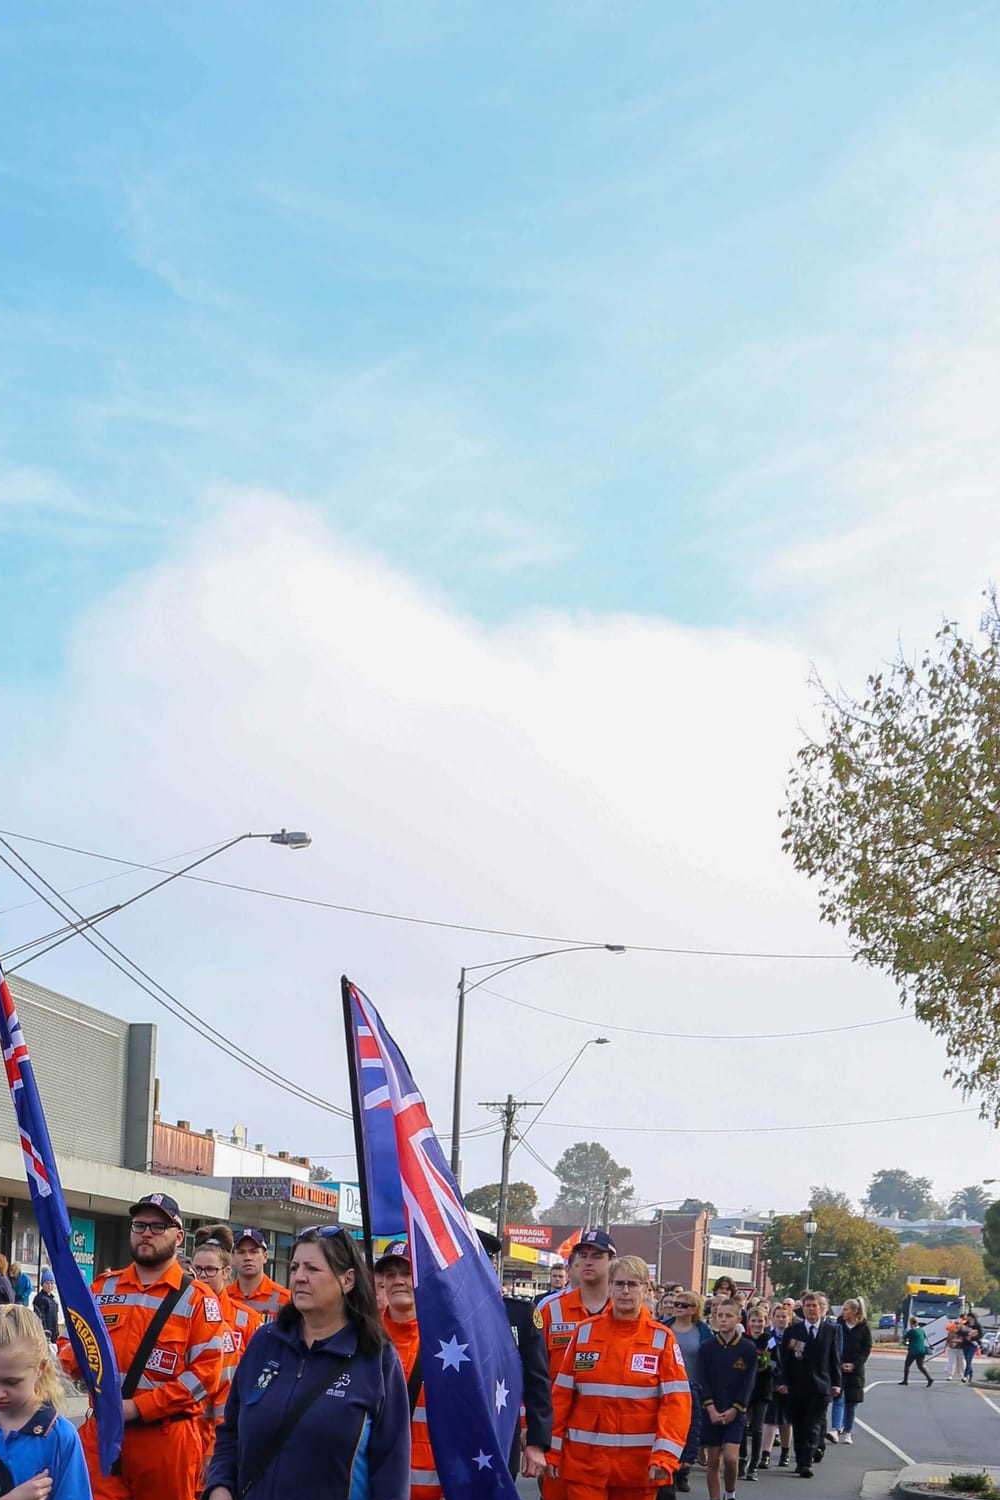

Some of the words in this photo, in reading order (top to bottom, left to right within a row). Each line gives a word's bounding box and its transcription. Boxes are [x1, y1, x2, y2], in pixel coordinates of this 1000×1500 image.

[240, 1186, 280, 1197] CAFE
[346, 1188, 362, 1215] De
[509, 1228, 546, 1236] WARRAGUL
[73, 1231, 86, 1246] Get
[511, 1236, 550, 1244] WSAGENCY
[100, 1295, 123, 1304] SES
[205, 1305, 219, 1314] SES
[70, 1314, 99, 1372] ERGENCY
[579, 1352, 594, 1360] SES
